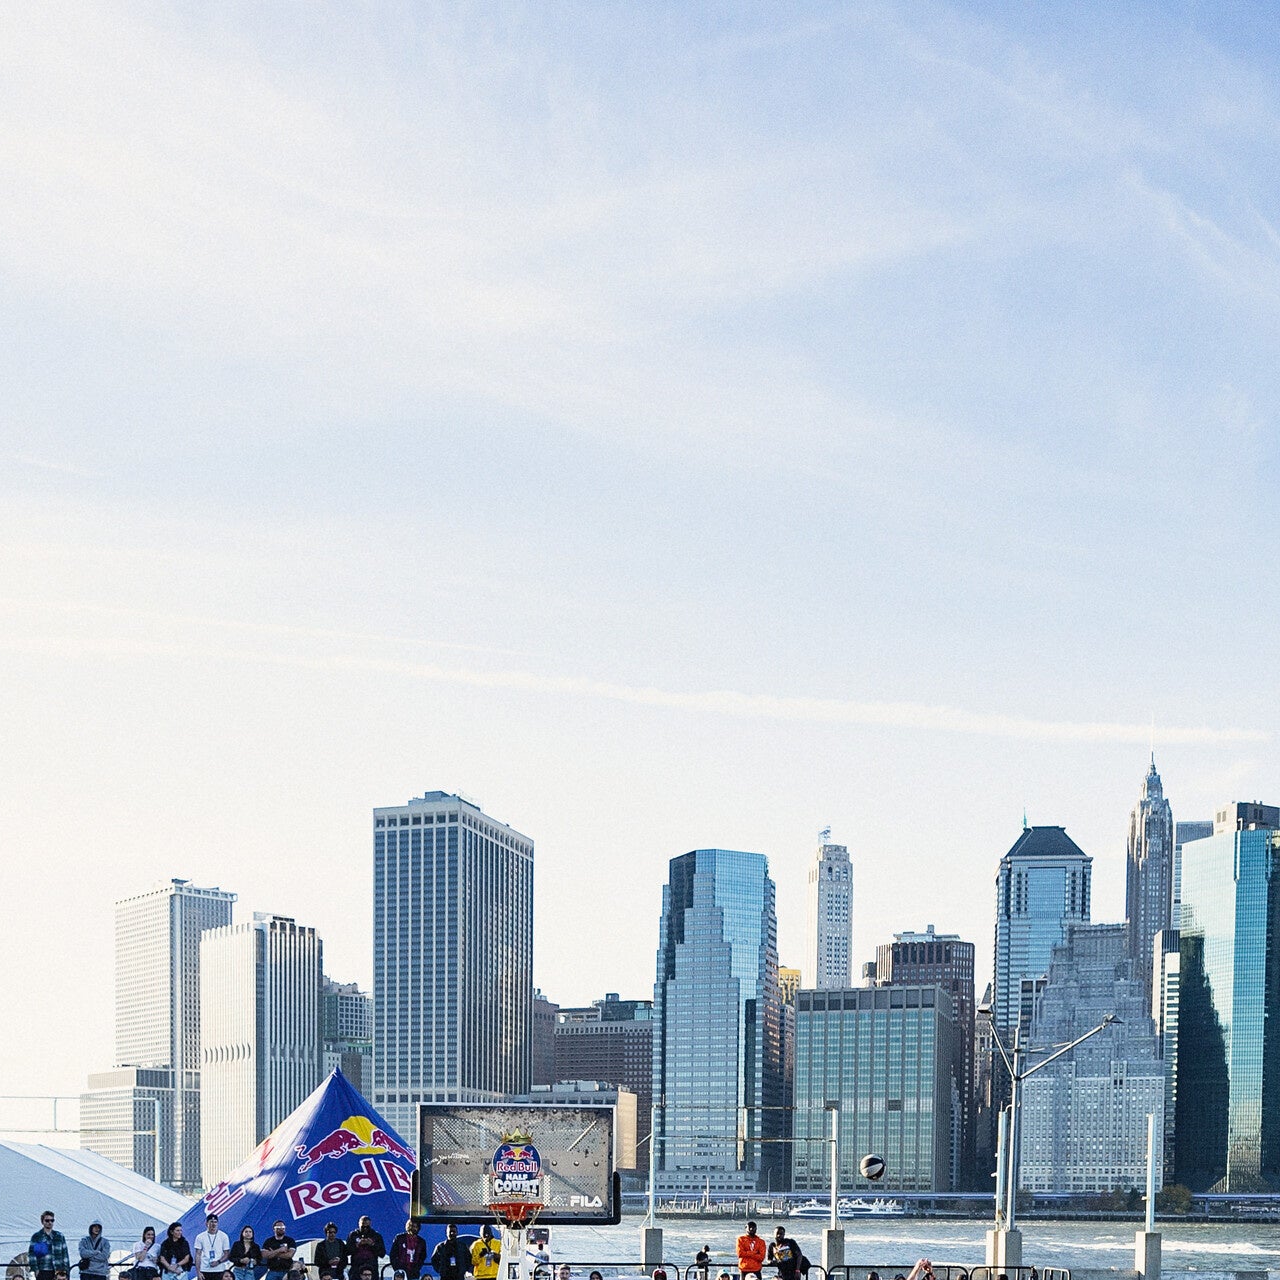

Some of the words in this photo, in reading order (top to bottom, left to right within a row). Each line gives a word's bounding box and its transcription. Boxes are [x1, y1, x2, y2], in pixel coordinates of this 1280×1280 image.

[497, 1161, 517, 1172] Red
[519, 1161, 538, 1172] Bull
[505, 1173, 528, 1181] HALF
[287, 1159, 384, 1219] Red
[494, 1179, 539, 1193] COURT
[570, 1196, 603, 1208] FILA
